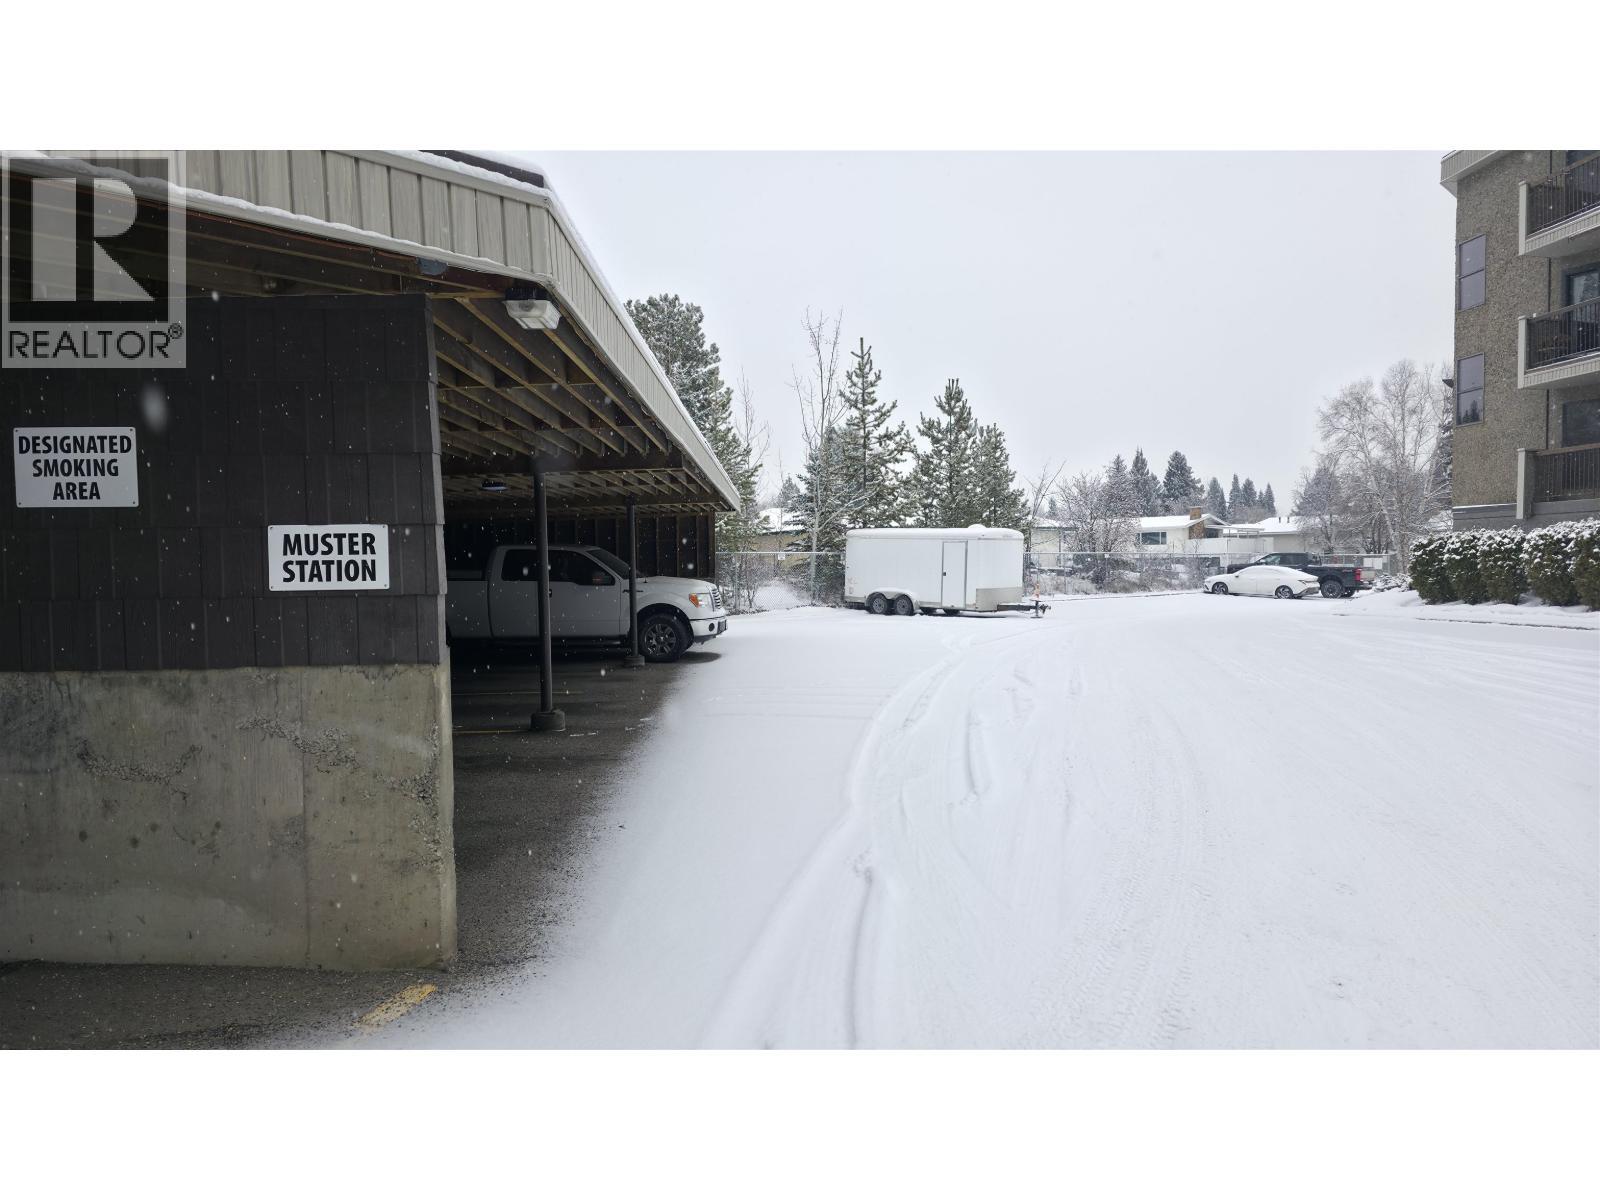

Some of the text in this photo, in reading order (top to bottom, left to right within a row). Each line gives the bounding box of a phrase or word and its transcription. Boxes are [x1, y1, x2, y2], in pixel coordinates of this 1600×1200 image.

[18, 435, 132, 454] DESIGNATED
[32, 458, 119, 477] SMOKING
[52, 481, 101, 500] AREA
[282, 532, 376, 556] MUSTER
[282, 559, 377, 583] STATION
